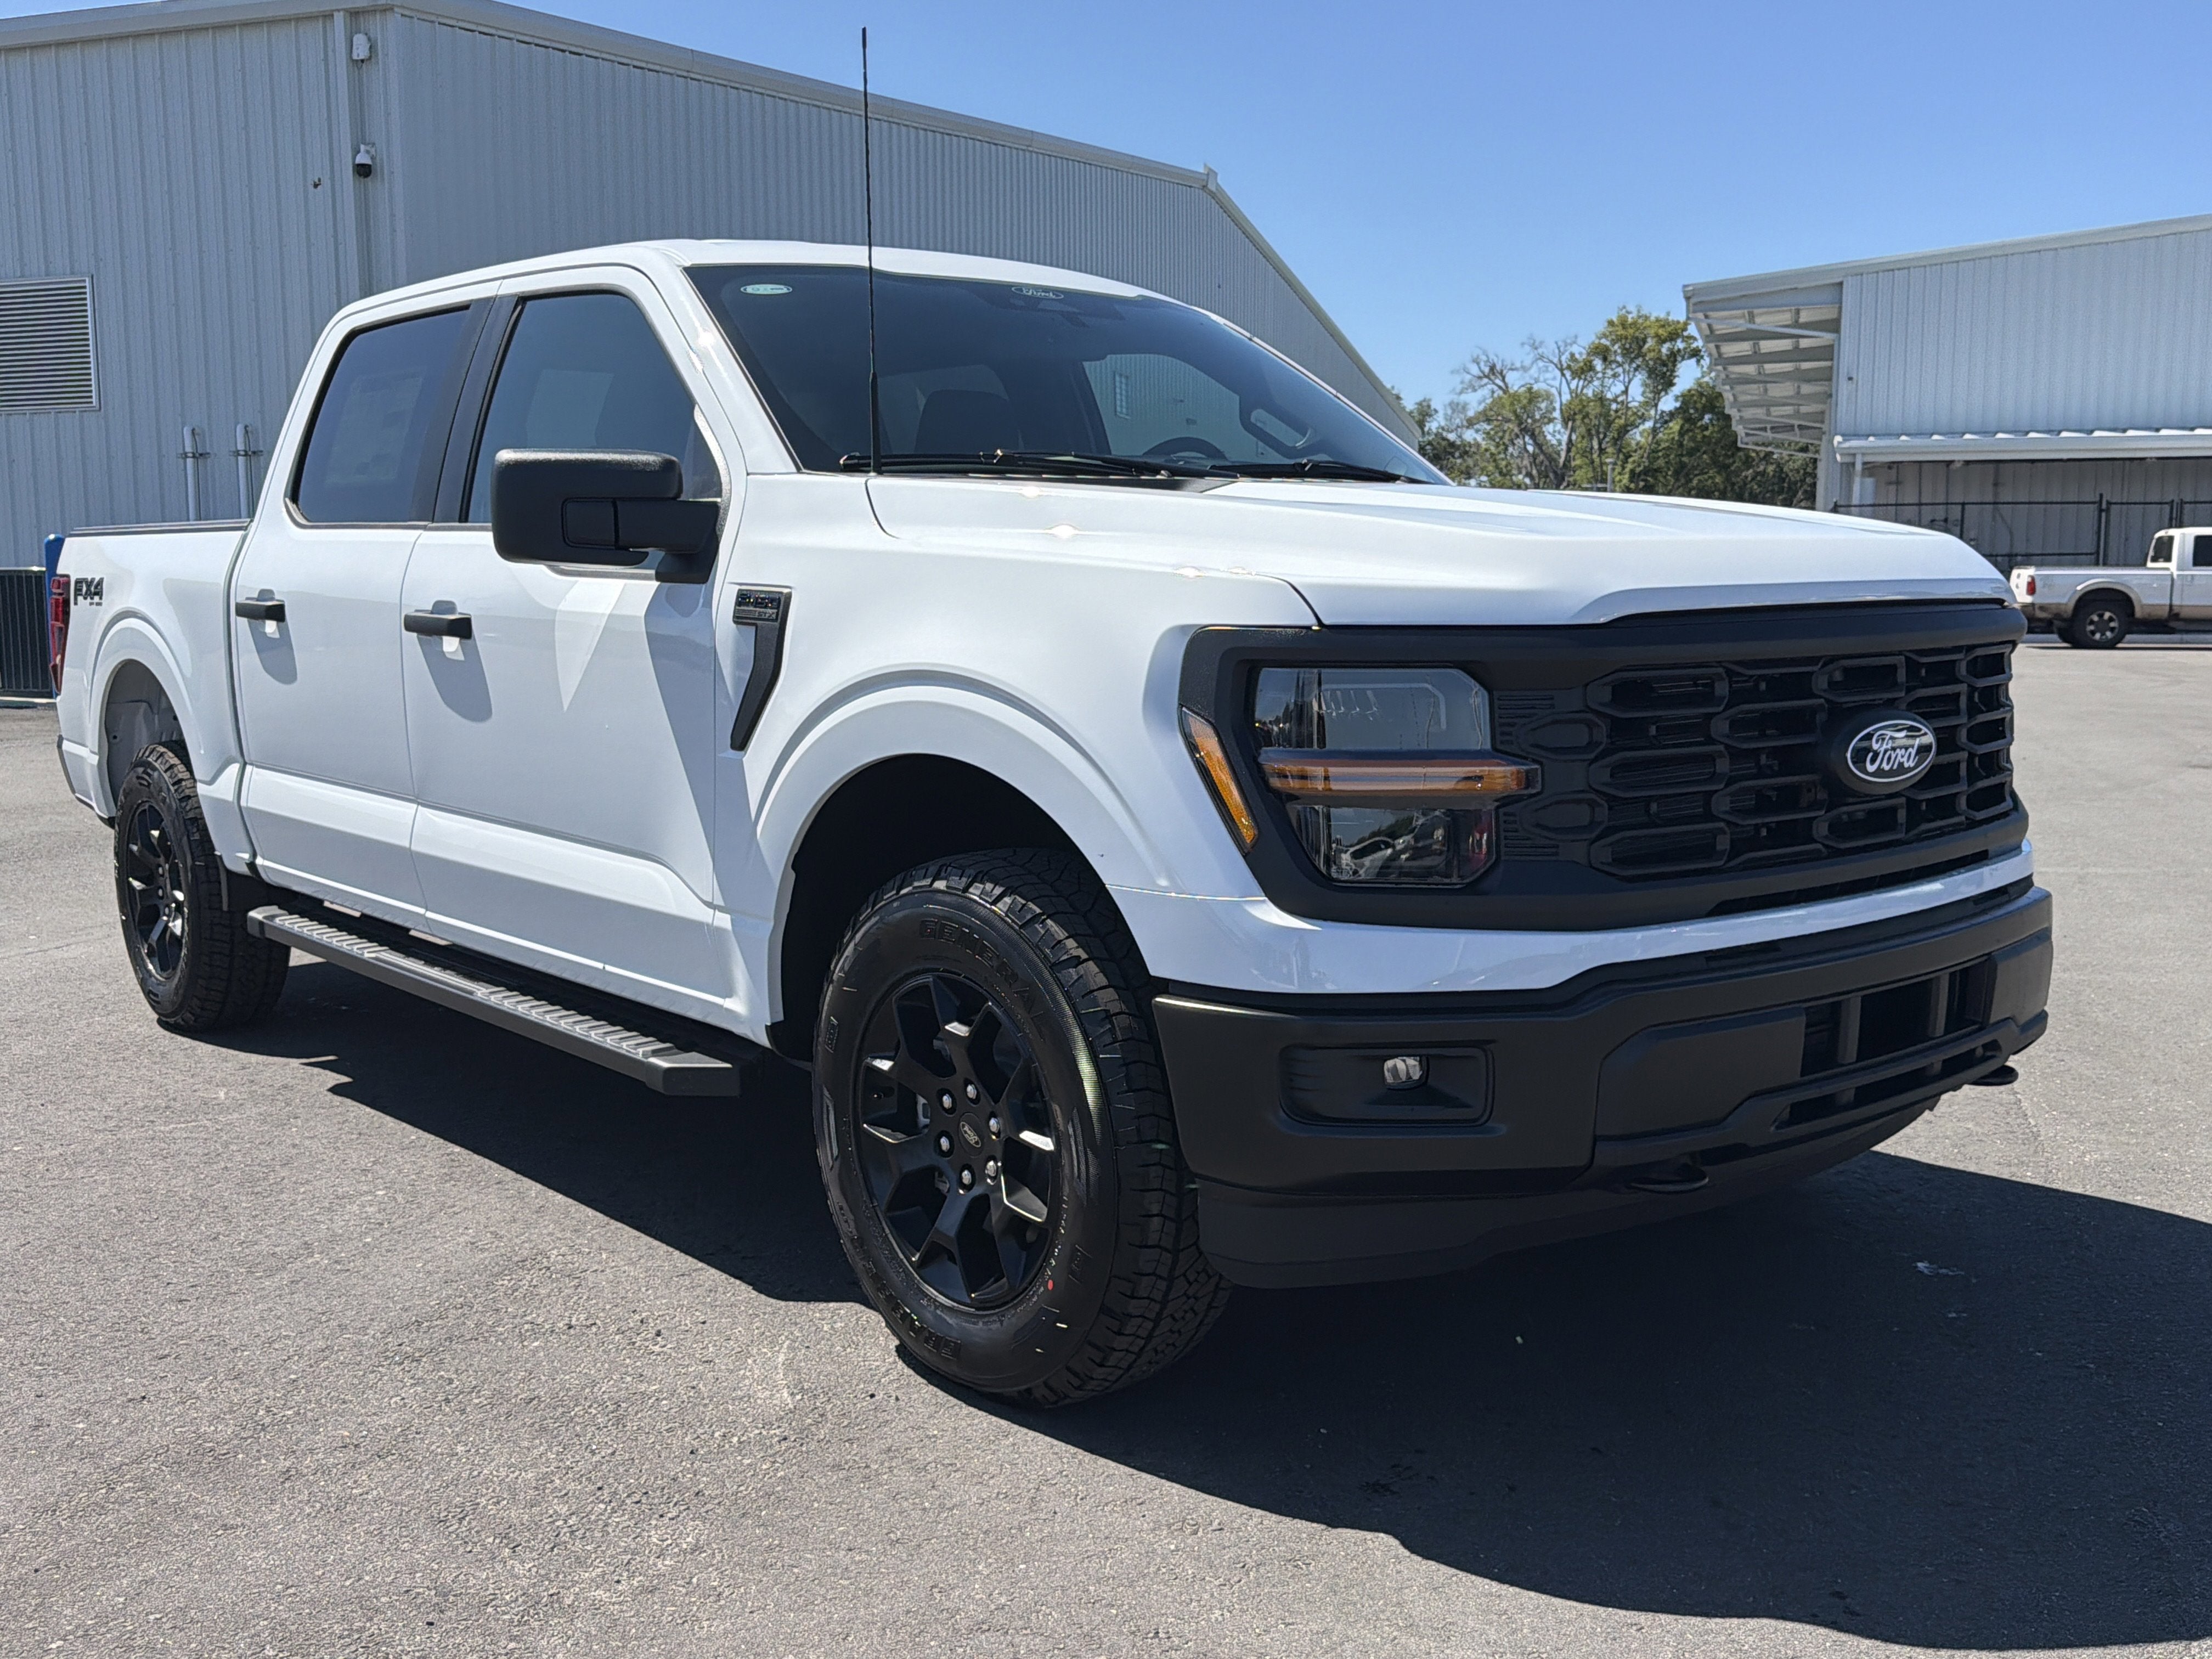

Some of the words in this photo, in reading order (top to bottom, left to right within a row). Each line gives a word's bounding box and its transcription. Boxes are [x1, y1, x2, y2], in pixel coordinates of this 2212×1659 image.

[74, 577, 104, 606] FX4
[1866, 730, 1920, 772] Ford
[919, 918, 1043, 1041] GENERAL
